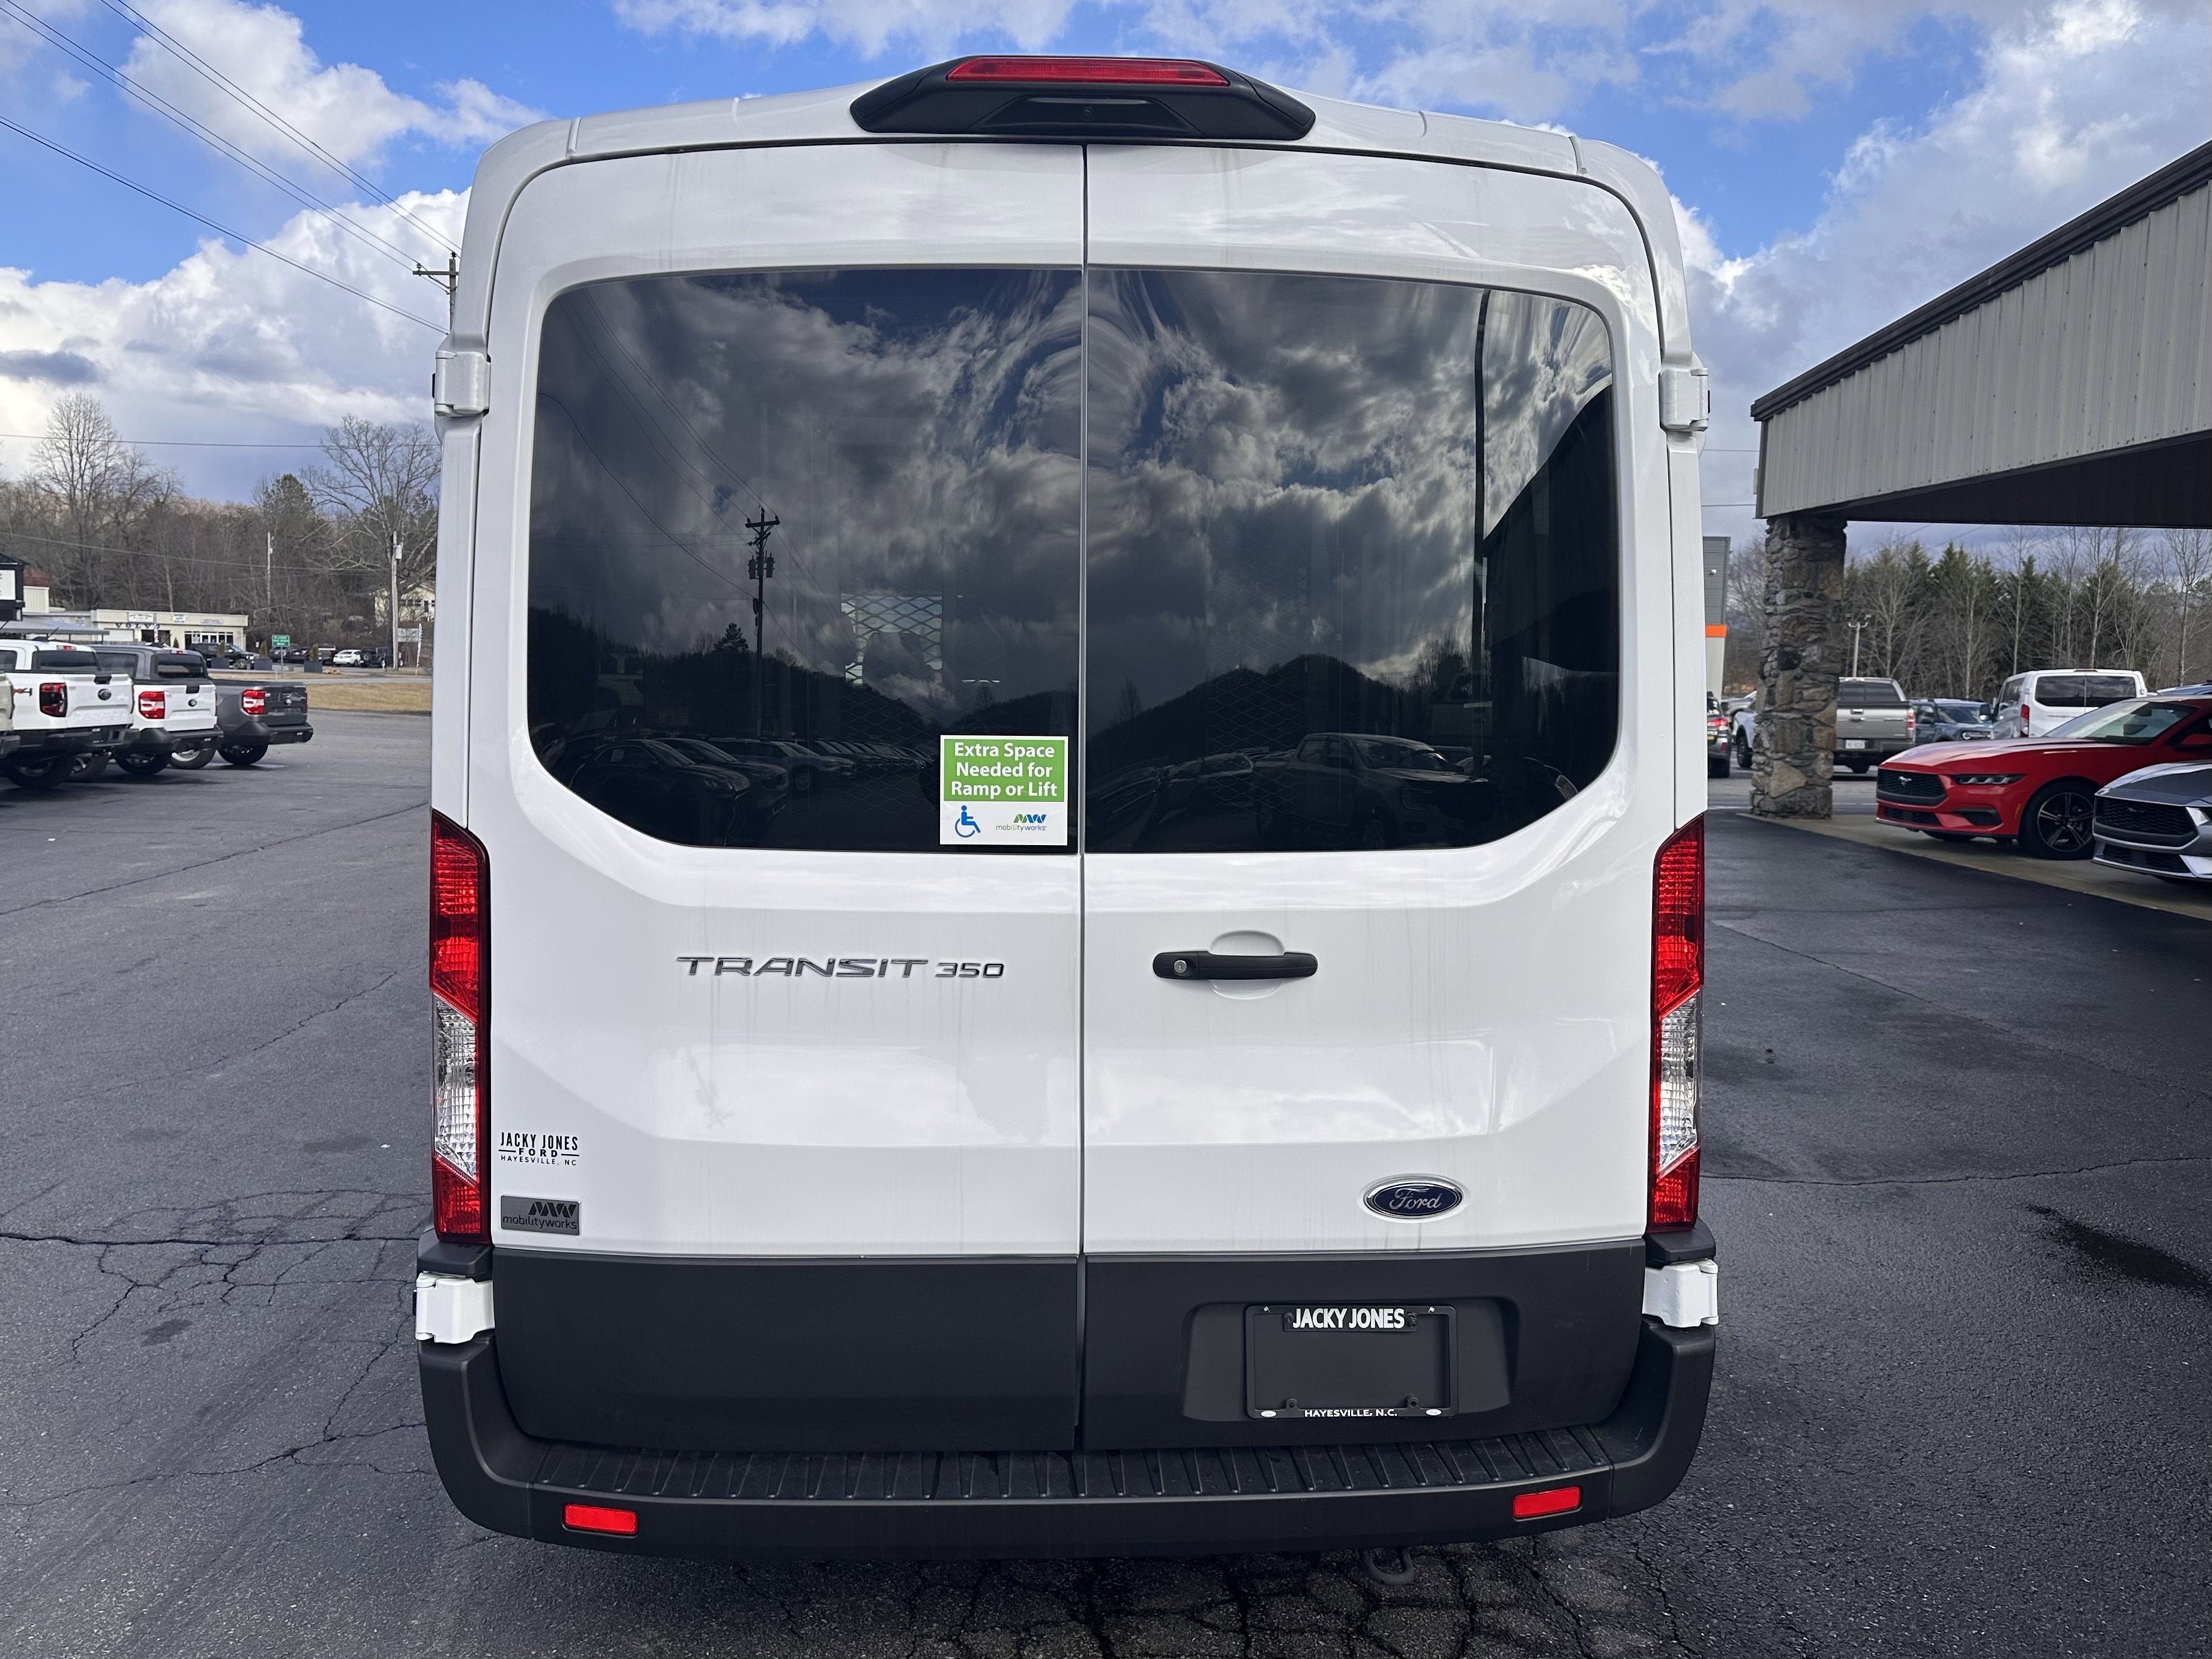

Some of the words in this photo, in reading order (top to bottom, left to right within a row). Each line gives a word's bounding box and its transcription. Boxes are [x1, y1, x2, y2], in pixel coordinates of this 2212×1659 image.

[954, 742, 999, 757] Extra
[1004, 742, 1055, 760] Space
[956, 762, 1023, 777] Needed
[1028, 762, 1053, 777] for
[951, 781, 1001, 799] Ramp
[1005, 784, 1024, 796] or
[1028, 781, 1057, 796] Lift
[677, 956, 928, 977] TRANSIT
[936, 962, 1004, 978] 350
[501, 1132, 536, 1148] JACKY
[542, 1135, 577, 1151] JONES
[519, 1148, 558, 1157] FORD
[1389, 1188, 1441, 1209] Ford
[502, 1215, 577, 1229] mobilityworks
[1292, 1308, 1347, 1328] JACKY
[1349, 1308, 1405, 1329] JONES
